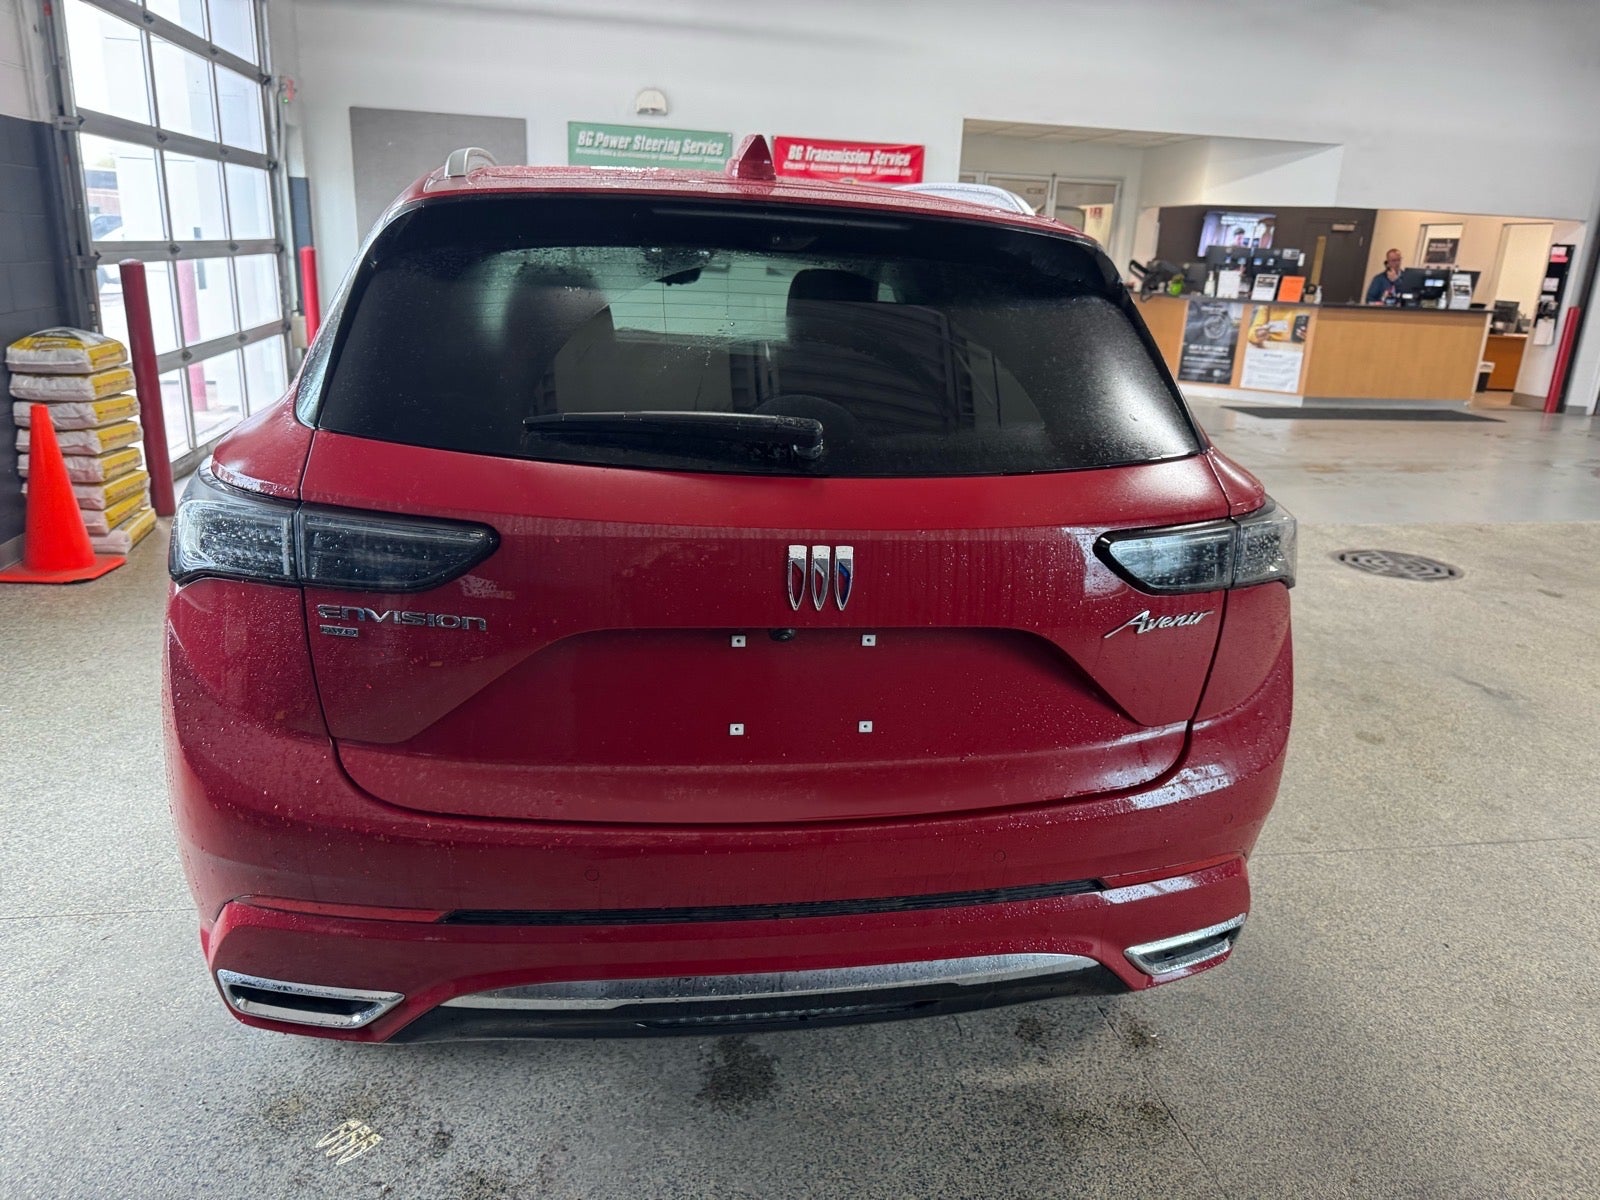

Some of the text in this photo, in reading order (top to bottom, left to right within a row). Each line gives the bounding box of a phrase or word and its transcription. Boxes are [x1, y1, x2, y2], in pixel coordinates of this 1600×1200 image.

[578, 130, 723, 156] BG Power Steering Service
[789, 145, 911, 166] BG Transmission Service
[1104, 609, 1214, 639] Avenir
